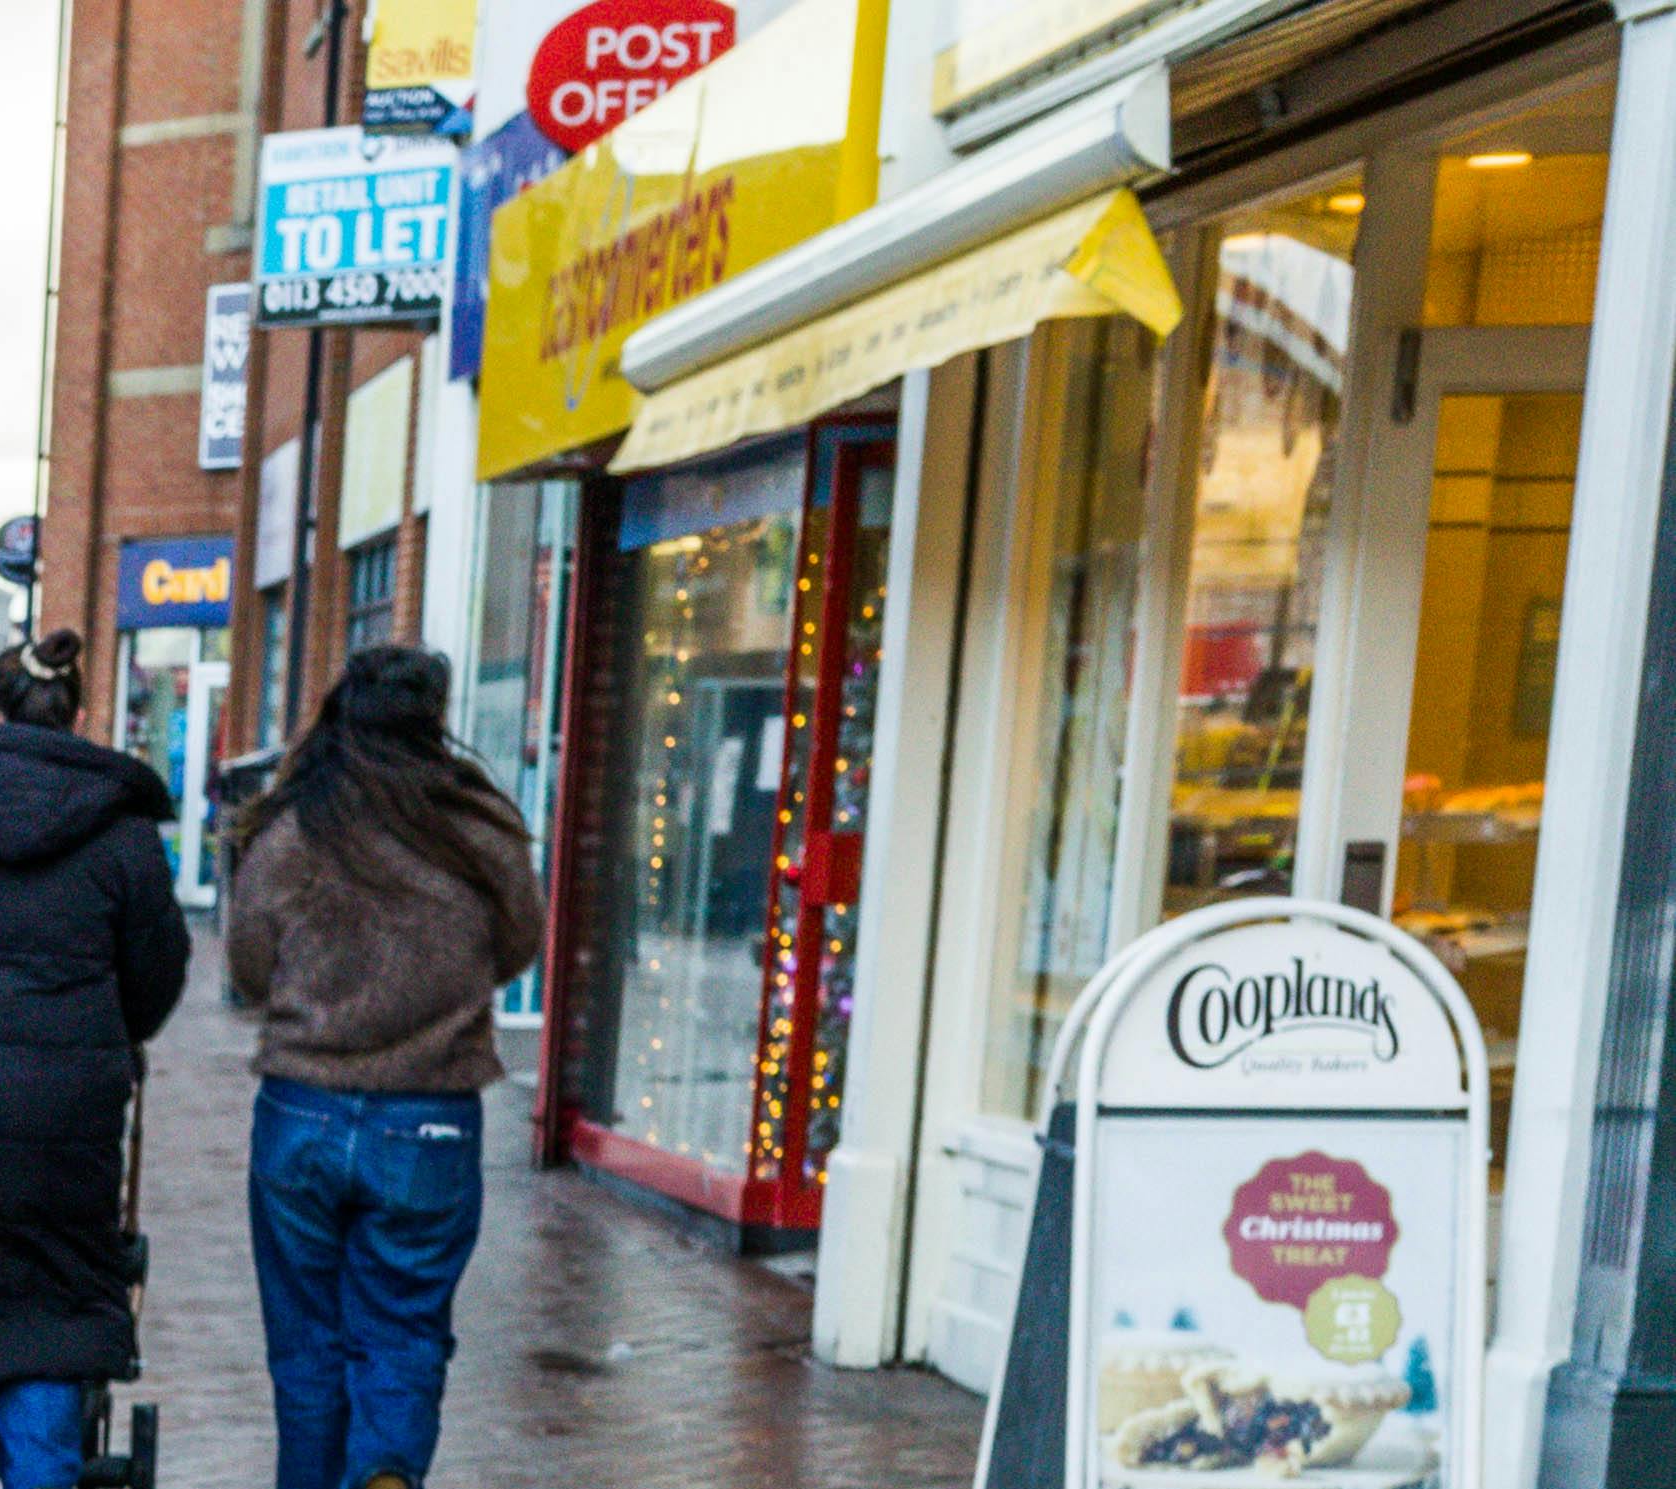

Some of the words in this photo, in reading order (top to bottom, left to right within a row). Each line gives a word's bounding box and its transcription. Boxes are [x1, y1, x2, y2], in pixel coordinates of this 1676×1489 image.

[586, 22, 723, 70] POST
[550, 79, 668, 127] OFF
[285, 178, 372, 214] RETAIL
[375, 170, 442, 209] UNIT
[276, 214, 343, 273] TO
[355, 206, 446, 266] LET
[264, 278, 319, 312] 0113
[326, 273, 379, 305] 450
[142, 558, 230, 605] Card
[1167, 956, 1399, 1070] Cooplands
[1269, 1193, 1354, 1214] SWEET
[1289, 1173, 1335, 1194] THE
[1240, 1215, 1384, 1241] Christmas
[1271, 1246, 1348, 1265] TREAT
